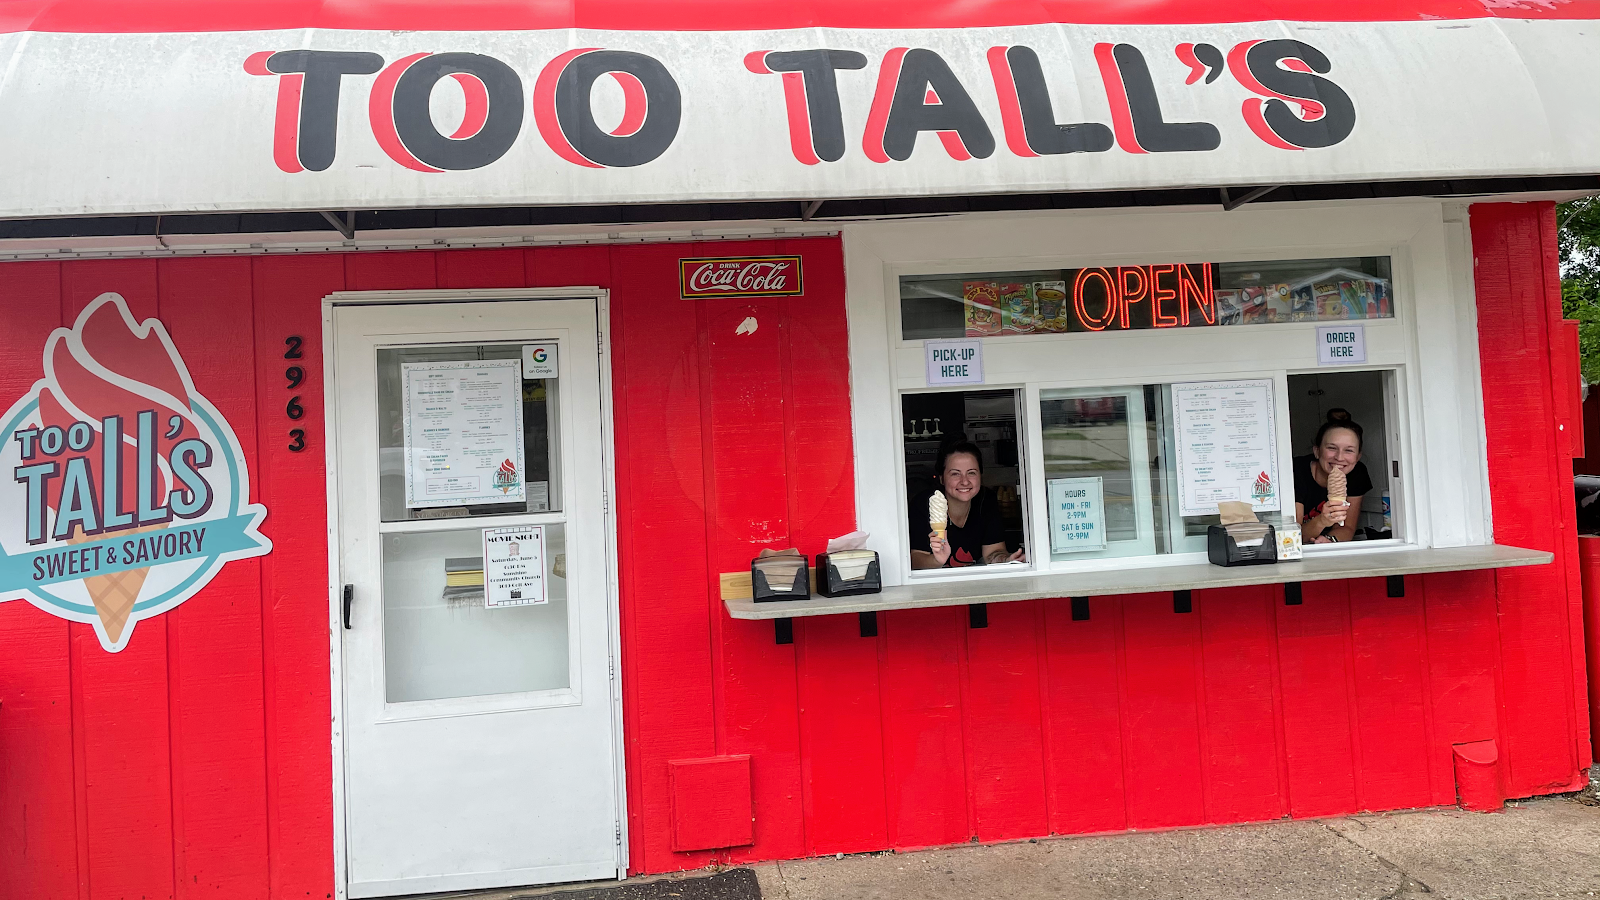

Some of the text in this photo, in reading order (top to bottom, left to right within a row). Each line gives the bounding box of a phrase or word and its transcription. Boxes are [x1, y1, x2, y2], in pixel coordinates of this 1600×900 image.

[243, 39, 1356, 173] TOO TALL'S
[690, 262, 791, 292] Coca-Cola
[1074, 262, 1215, 331] OPEN
[1326, 332, 1356, 344] ORDER
[933, 348, 975, 362] PICK-UP
[1330, 346, 1354, 358] HERE
[941, 365, 969, 378] HERE
[284, 336, 306, 452] 2963
[14, 421, 95, 461] TOO
[14, 409, 213, 546] TALL'S
[1065, 490, 1086, 498] HOURS
[1061, 502, 1075, 510] MON
[1067, 532, 1089, 540] 12-9PM
[33, 528, 206, 581] SWEET & SAVORY
